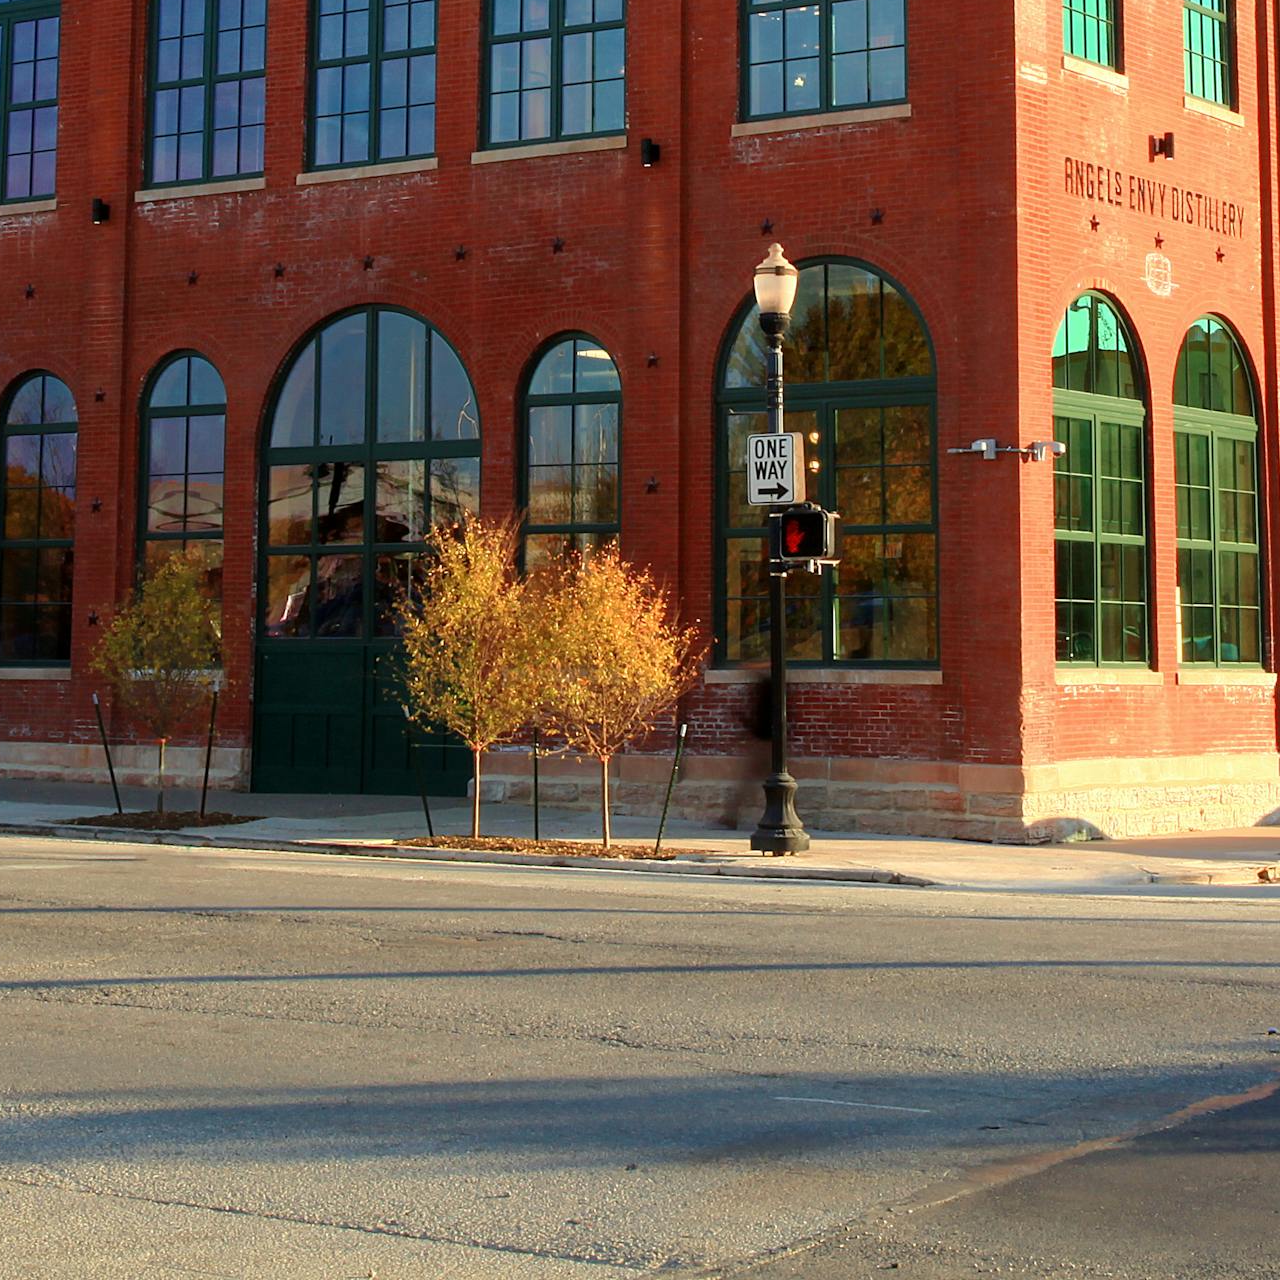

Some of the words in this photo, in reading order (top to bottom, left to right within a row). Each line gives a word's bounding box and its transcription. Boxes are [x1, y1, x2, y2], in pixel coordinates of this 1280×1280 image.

[1129, 175, 1166, 218] ENVY
[1172, 187, 1244, 239] DISTILLERY
[754, 438, 787, 459] ONE
[754, 460, 787, 480] WAY
